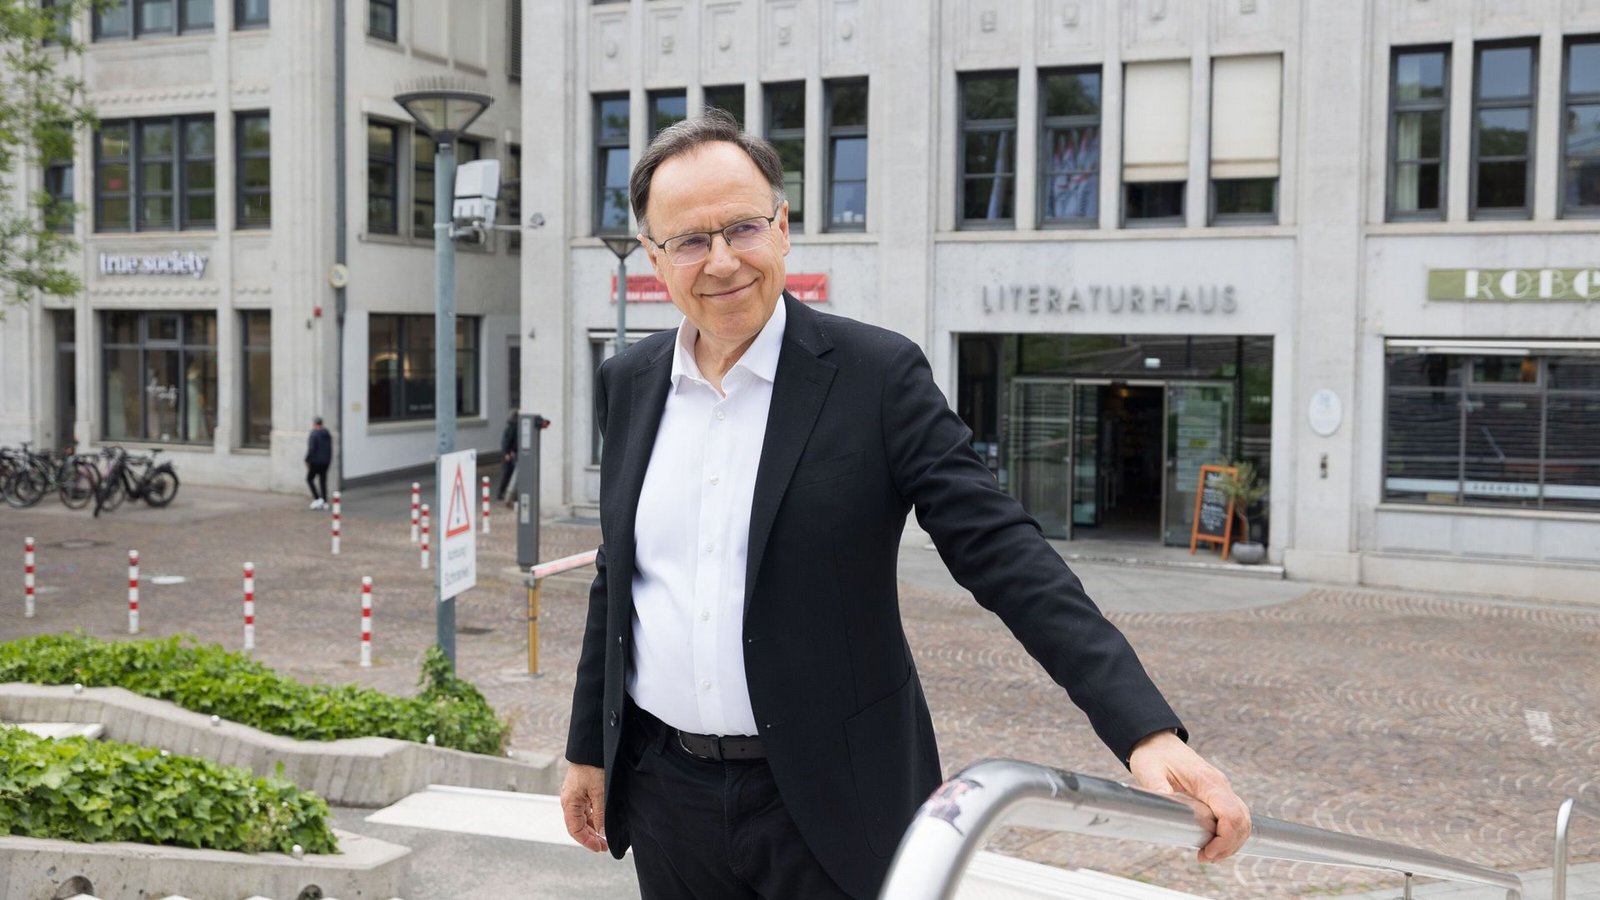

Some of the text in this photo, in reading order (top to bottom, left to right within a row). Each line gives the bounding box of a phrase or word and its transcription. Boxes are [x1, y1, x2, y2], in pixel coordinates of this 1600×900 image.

[99, 250, 209, 280] true society
[982, 284, 1238, 316] LITERATURHAUS
